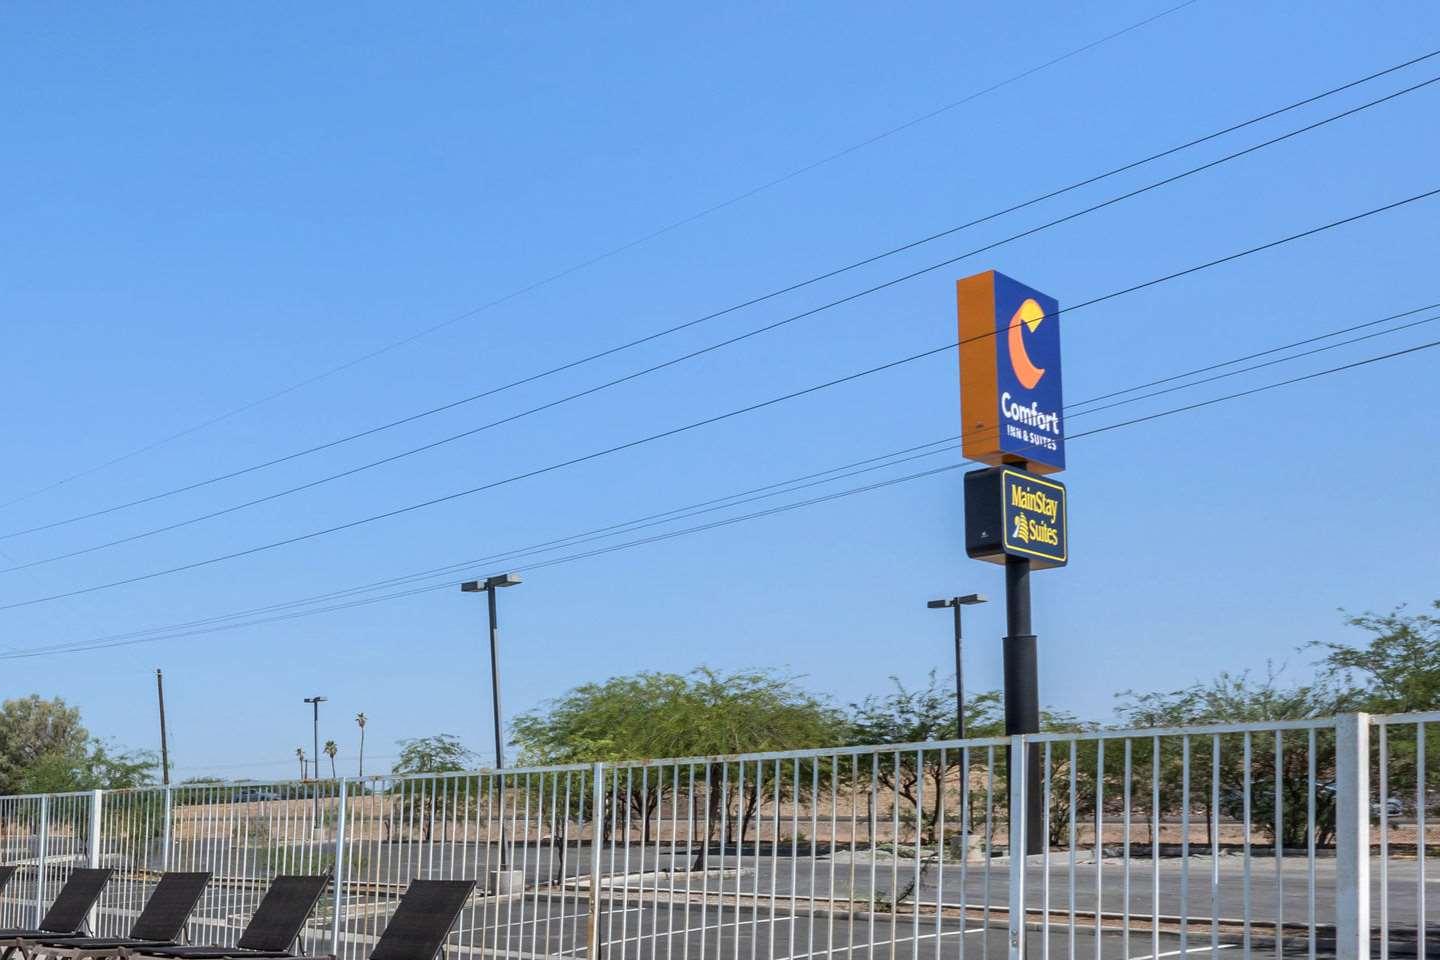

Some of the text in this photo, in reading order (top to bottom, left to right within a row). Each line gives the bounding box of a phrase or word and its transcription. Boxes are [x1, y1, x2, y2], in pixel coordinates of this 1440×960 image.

[1001, 392, 1059, 434] Comfort
[1011, 484, 1058, 524] MainStay
[1029, 519, 1058, 546] Suites
